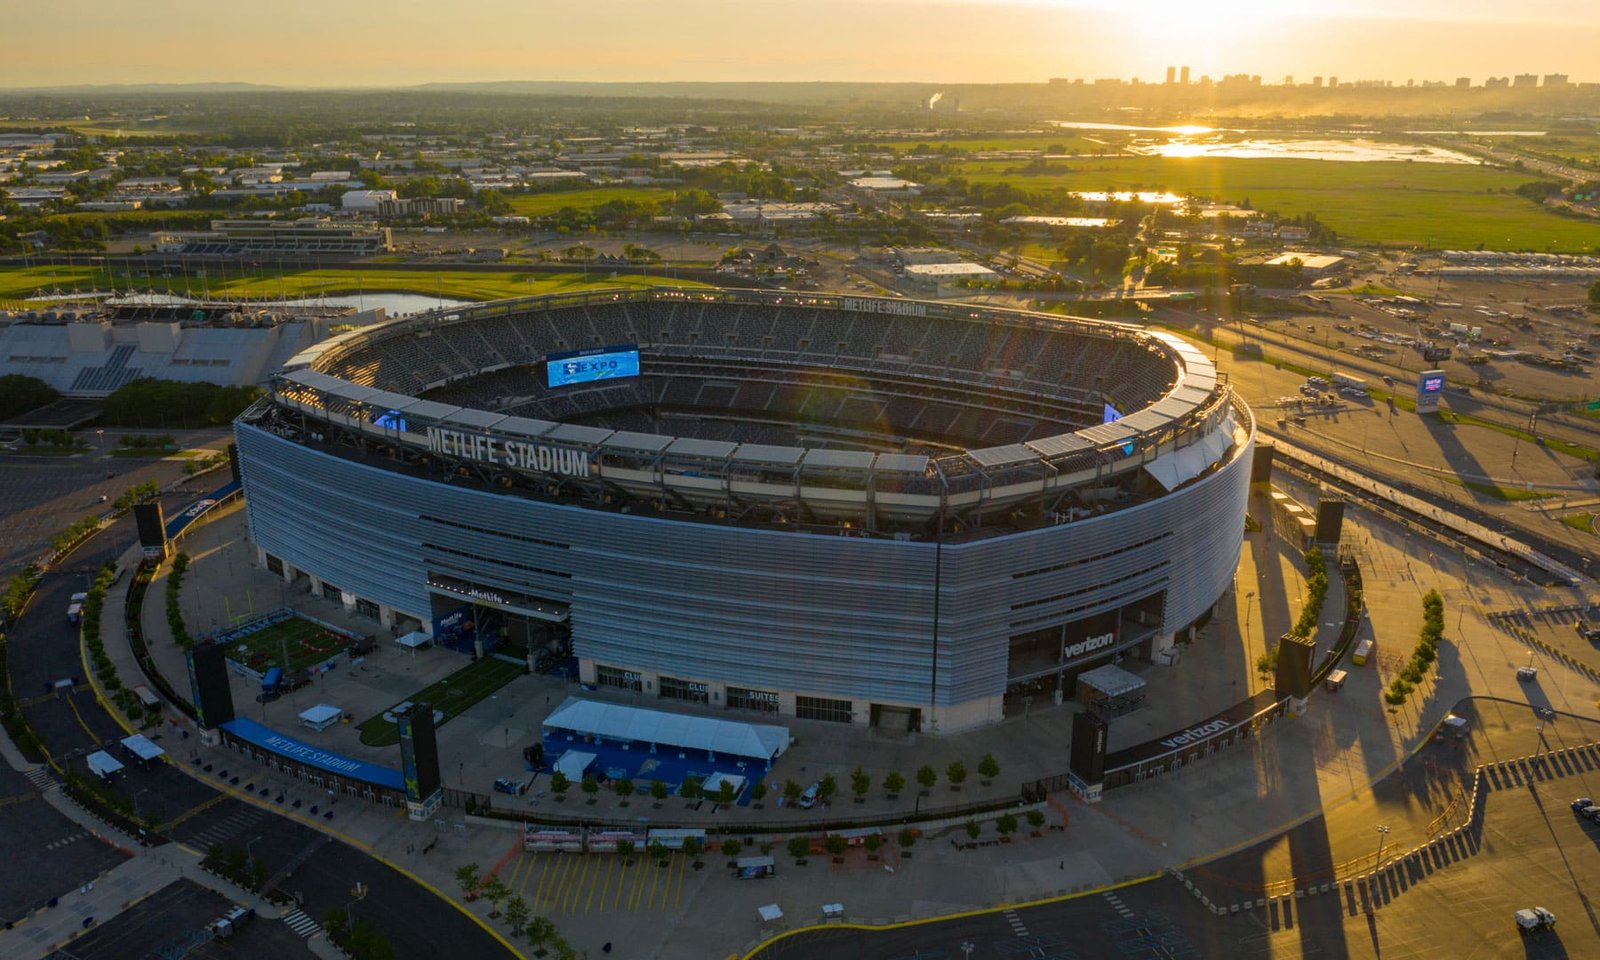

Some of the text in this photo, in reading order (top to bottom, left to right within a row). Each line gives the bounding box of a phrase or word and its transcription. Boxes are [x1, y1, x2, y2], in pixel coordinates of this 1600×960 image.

[844, 298, 926, 316] METLIFE STADIUM
[581, 360, 617, 372] EXPO
[427, 426, 589, 477] METLIFE STADIUM
[471, 588, 503, 603] MetLife
[1064, 632, 1113, 658] verizon
[624, 671, 641, 681] CLU
[749, 692, 780, 701] SUITES
[1160, 719, 1231, 748] verizon
[264, 736, 361, 772] METLIFE STADIUM
